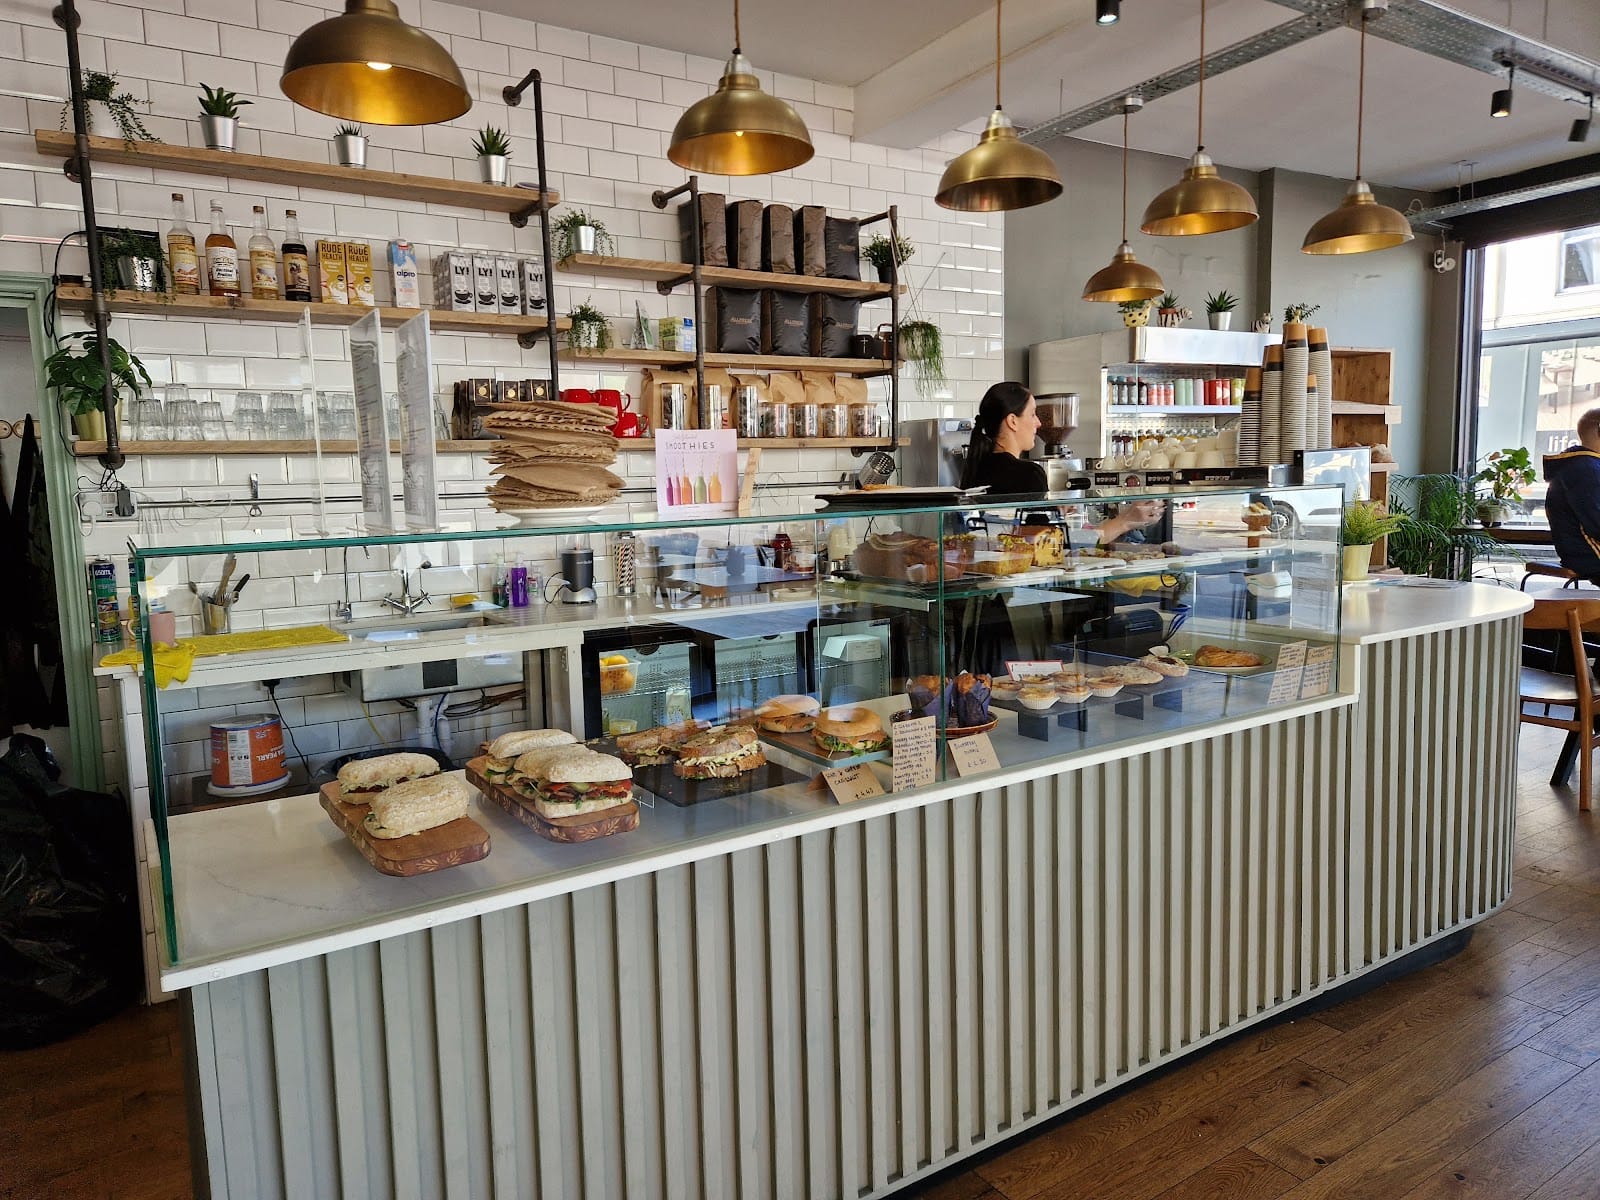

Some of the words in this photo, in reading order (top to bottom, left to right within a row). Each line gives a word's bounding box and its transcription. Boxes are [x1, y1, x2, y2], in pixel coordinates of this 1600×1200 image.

[321, 243, 342, 254] RUDE
[348, 245, 369, 256] RUDE
[321, 253, 343, 261] HEALTH
[348, 255, 369, 263] HEALTH
[396, 269, 416, 279] alpro
[454, 266, 470, 275] LY!
[478, 267, 493, 277] LY!
[501, 269, 515, 279] LY!
[529, 273, 543, 282] LY!
[665, 441, 716, 450] SMOOTHIES
